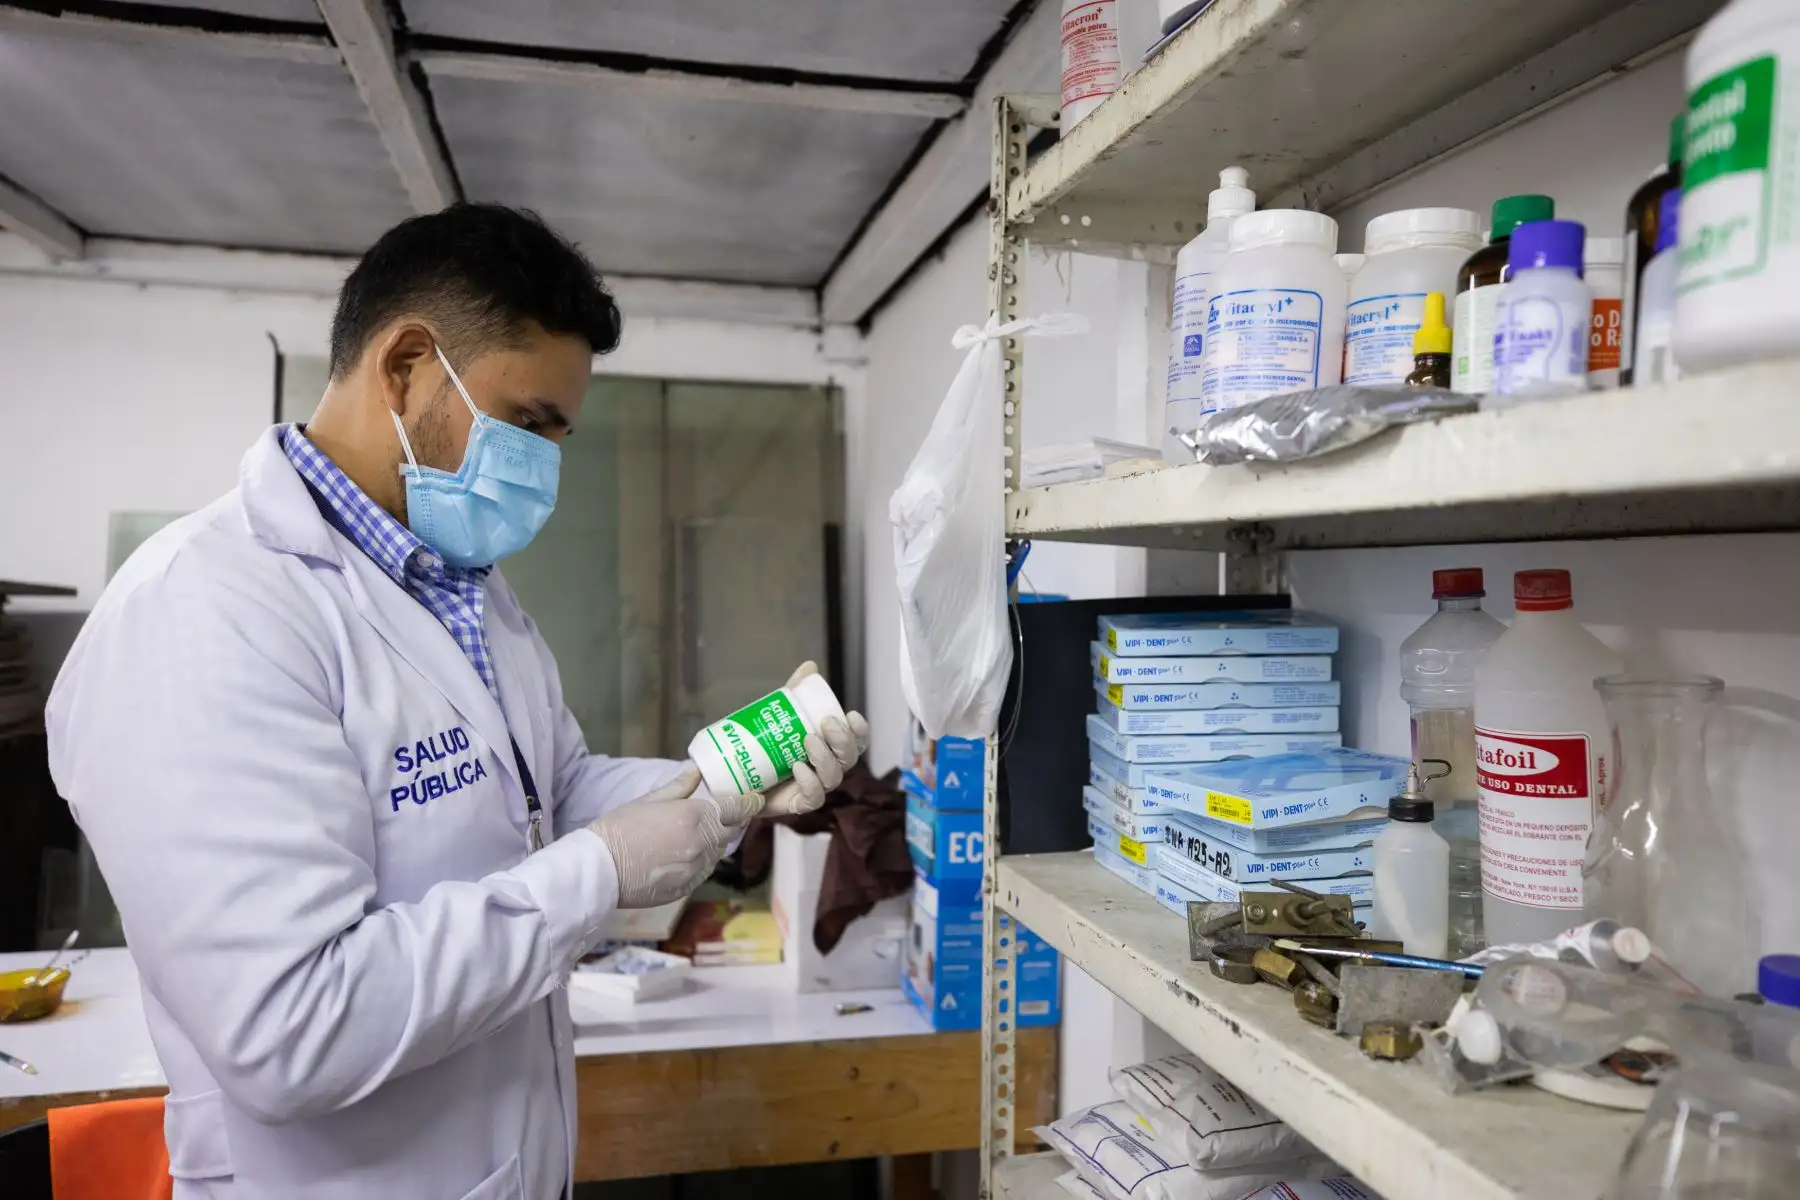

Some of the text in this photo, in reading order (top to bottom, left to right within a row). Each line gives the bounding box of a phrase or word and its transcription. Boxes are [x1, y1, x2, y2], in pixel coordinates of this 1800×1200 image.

[1146, 639, 1166, 647] DENT
[1154, 694, 1173, 702] DENT
[760, 706, 784, 741] Curado
[394, 727, 470, 772] SALUD
[390, 758, 487, 812] PÚBLICA
[1488, 778, 1510, 790] USO
[1514, 782, 1577, 794] DENTAL
[1262, 808, 1278, 819] VIPI
[1284, 804, 1303, 815] DENT
[1507, 852, 1557, 865] PRECAUCIONES
[1247, 864, 1264, 873] VIPI
[1270, 862, 1291, 872] DENT
[1504, 863, 1518, 871] CREA
[1524, 892, 1551, 901] FRESCO
